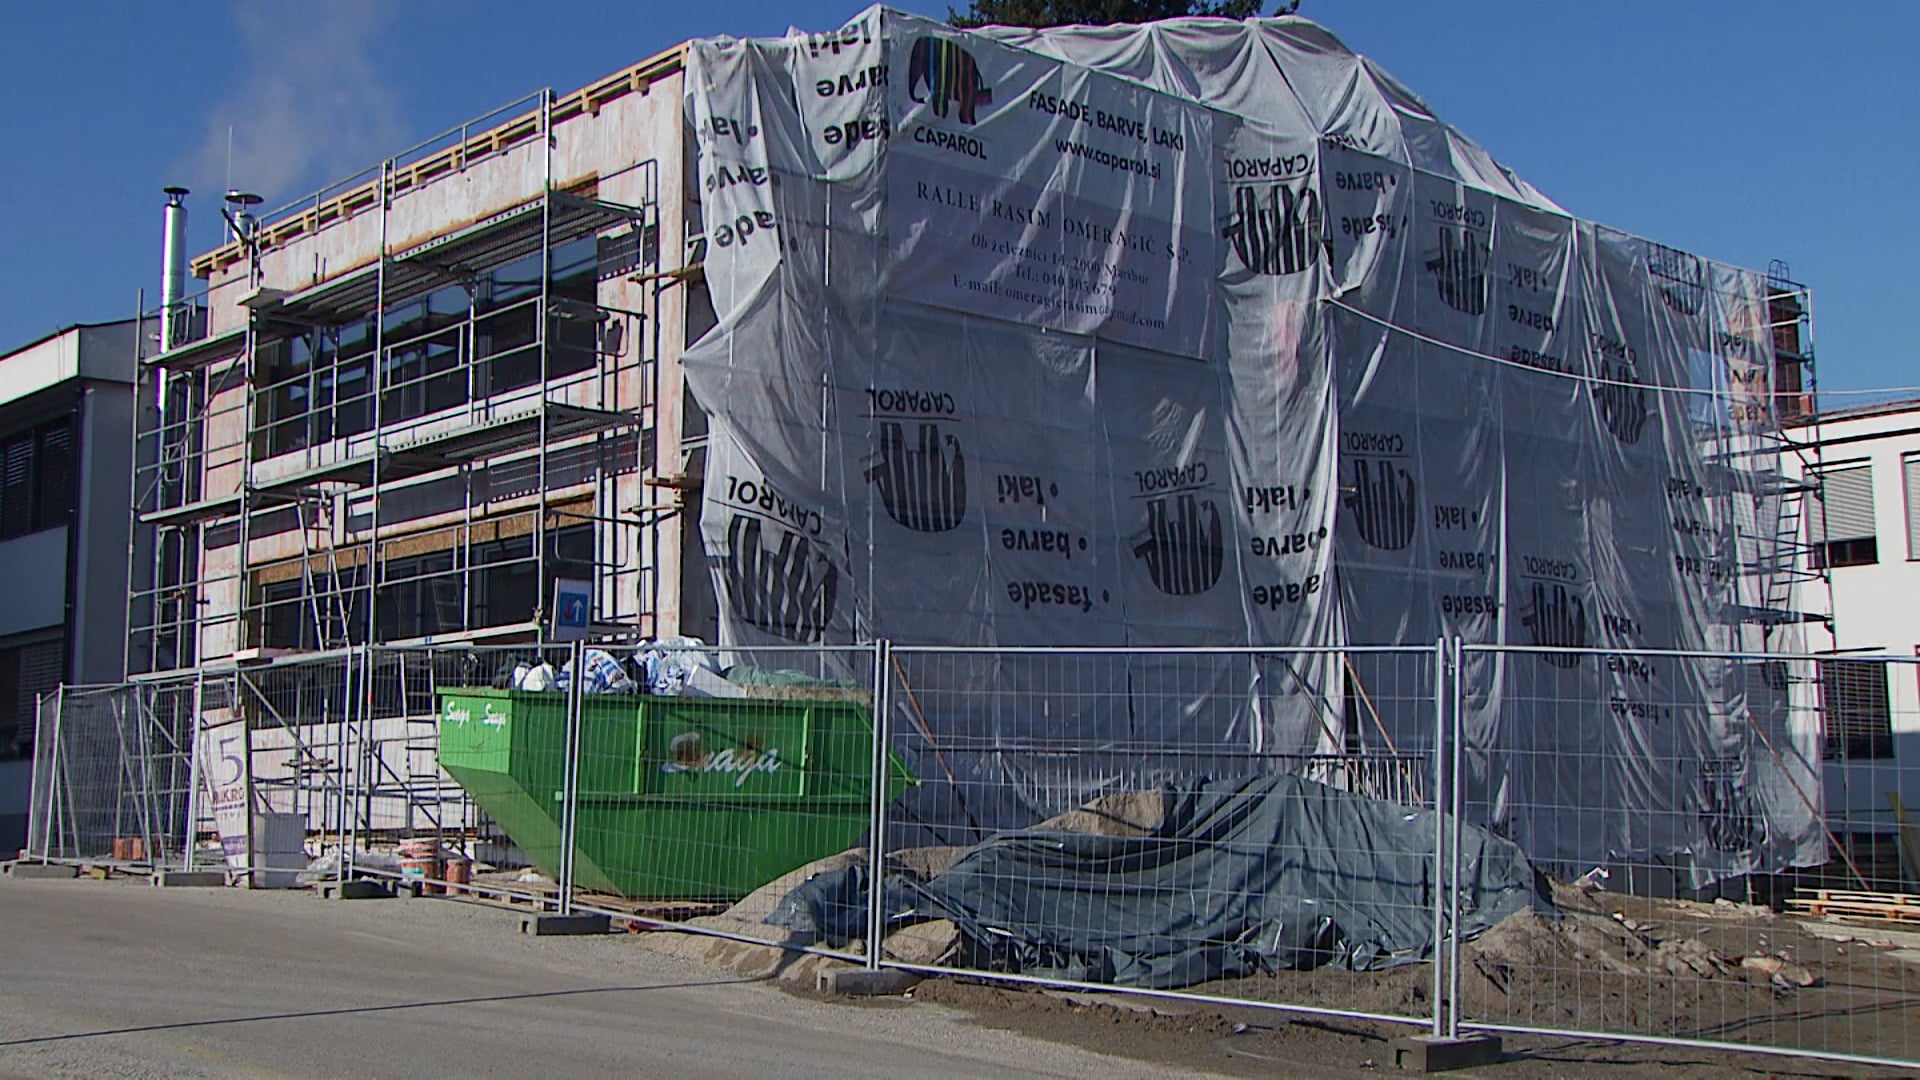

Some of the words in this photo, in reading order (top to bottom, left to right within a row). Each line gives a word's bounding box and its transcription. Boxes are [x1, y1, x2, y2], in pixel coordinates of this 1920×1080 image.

[1029, 90, 1093, 128] FASADE,
[1096, 109, 1148, 144] BARVE,
[1152, 127, 1185, 152] LAKI
[914, 125, 988, 161] CAPAROL
[1056, 138, 1162, 181] www.caparol.si
[1224, 153, 1309, 179] CAPAROL
[1335, 171, 1386, 193] barve
[917, 181, 982, 213] RALLE
[992, 199, 1051, 229] RASIM
[1430, 200, 1486, 229] CAPAROL
[866, 388, 955, 414] CAPAROL
[1344, 432, 1404, 453] CAPAROL
[998, 474, 1044, 505] laki
[1134, 462, 1208, 493] CAPAROL
[1246, 486, 1297, 514] laki
[1435, 505, 1467, 531] laki
[1001, 528, 1071, 559] barve
[1440, 551, 1485, 575] barve
[1523, 556, 1577, 580] CAPAROL
[1007, 581, 1093, 613] fasade
[219, 735, 245, 786] 5
